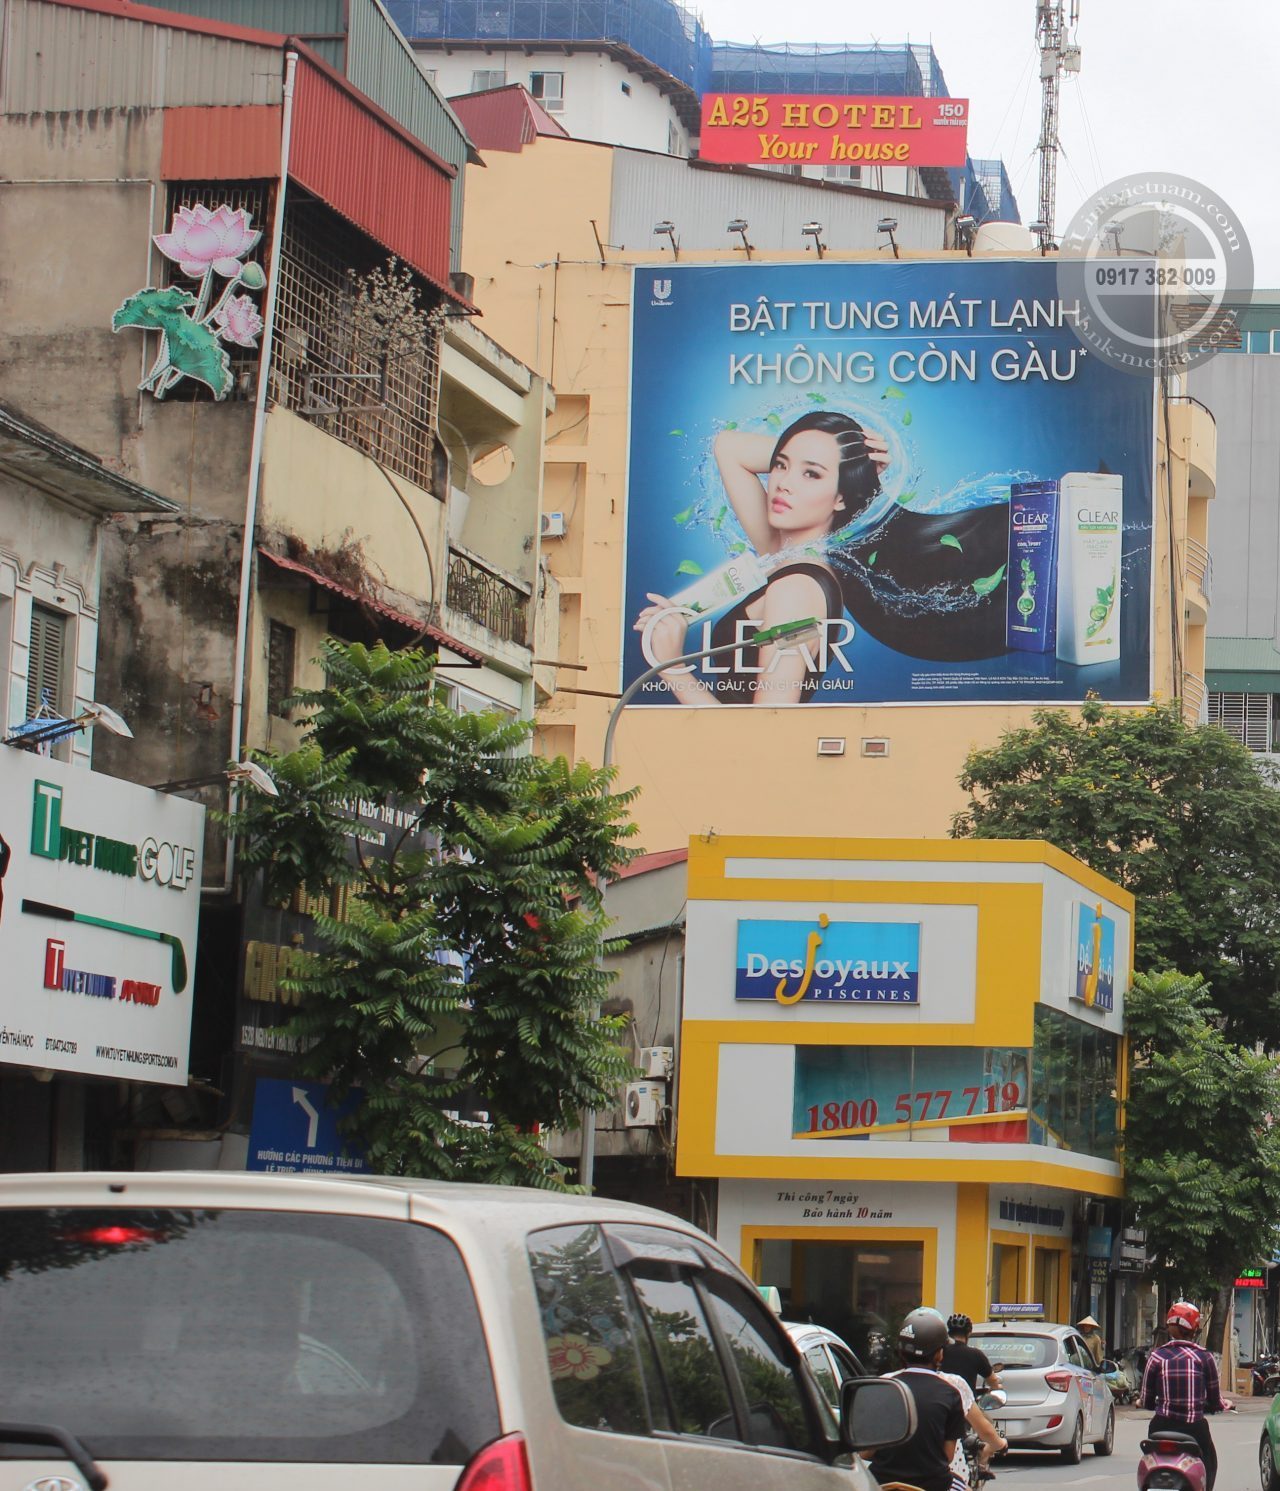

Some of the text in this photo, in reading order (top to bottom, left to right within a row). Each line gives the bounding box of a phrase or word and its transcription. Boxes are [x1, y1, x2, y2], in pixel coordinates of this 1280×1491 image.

[707, 97, 922, 129] A25 HOTEL
[938, 104, 964, 117] 150
[758, 134, 910, 161] Your house
[729, 296, 796, 337] BẬT
[802, 301, 899, 330] TUNG
[909, 293, 981, 329] MÁT
[728, 344, 875, 385] KHÔNG
[889, 342, 977, 382] CÒN
[1013, 511, 1049, 525] CLEAR
[1077, 508, 1118, 523] CLEAR
[641, 607, 855, 674] CLEAR
[139, 837, 194, 889] GOLF
[814, 988, 911, 1001] PISCINES
[807, 1082, 1020, 1133] 1800 577 719
[257, 1147, 284, 1162] HƯỚNG
[285, 1149, 301, 1163] CÁC
[302, 1154, 334, 1166] PHƯƠNG
[798, 1192, 825, 1204] công
[826, 1190, 833, 1201] 7
[833, 1191, 859, 1204] ngày
[826, 1208, 852, 1218] hành
[856, 1207, 868, 1219] 10
[870, 1209, 893, 1219] năm
